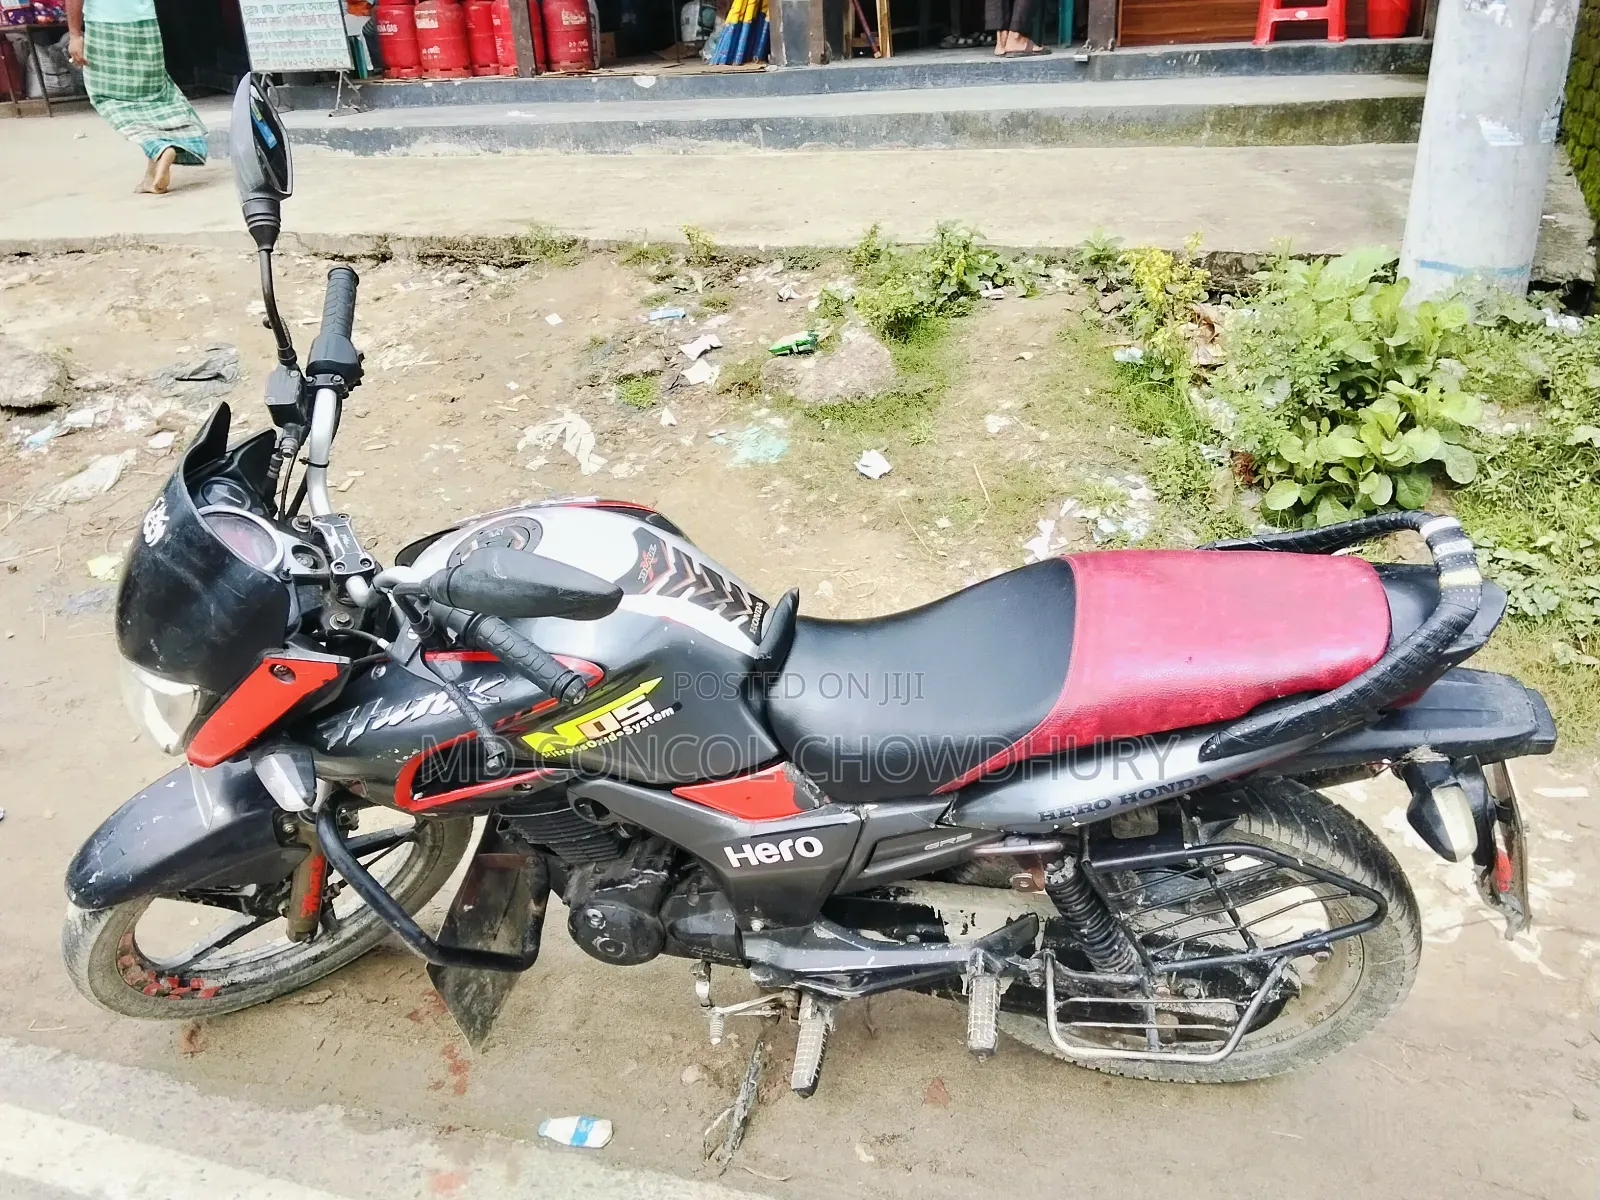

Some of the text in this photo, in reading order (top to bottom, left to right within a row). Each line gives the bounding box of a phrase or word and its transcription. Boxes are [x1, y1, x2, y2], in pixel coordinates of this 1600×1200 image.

[749, 601, 764, 634] HONDA
[1039, 774, 1212, 822] HERO HONDA
[723, 836, 823, 868] Hero
